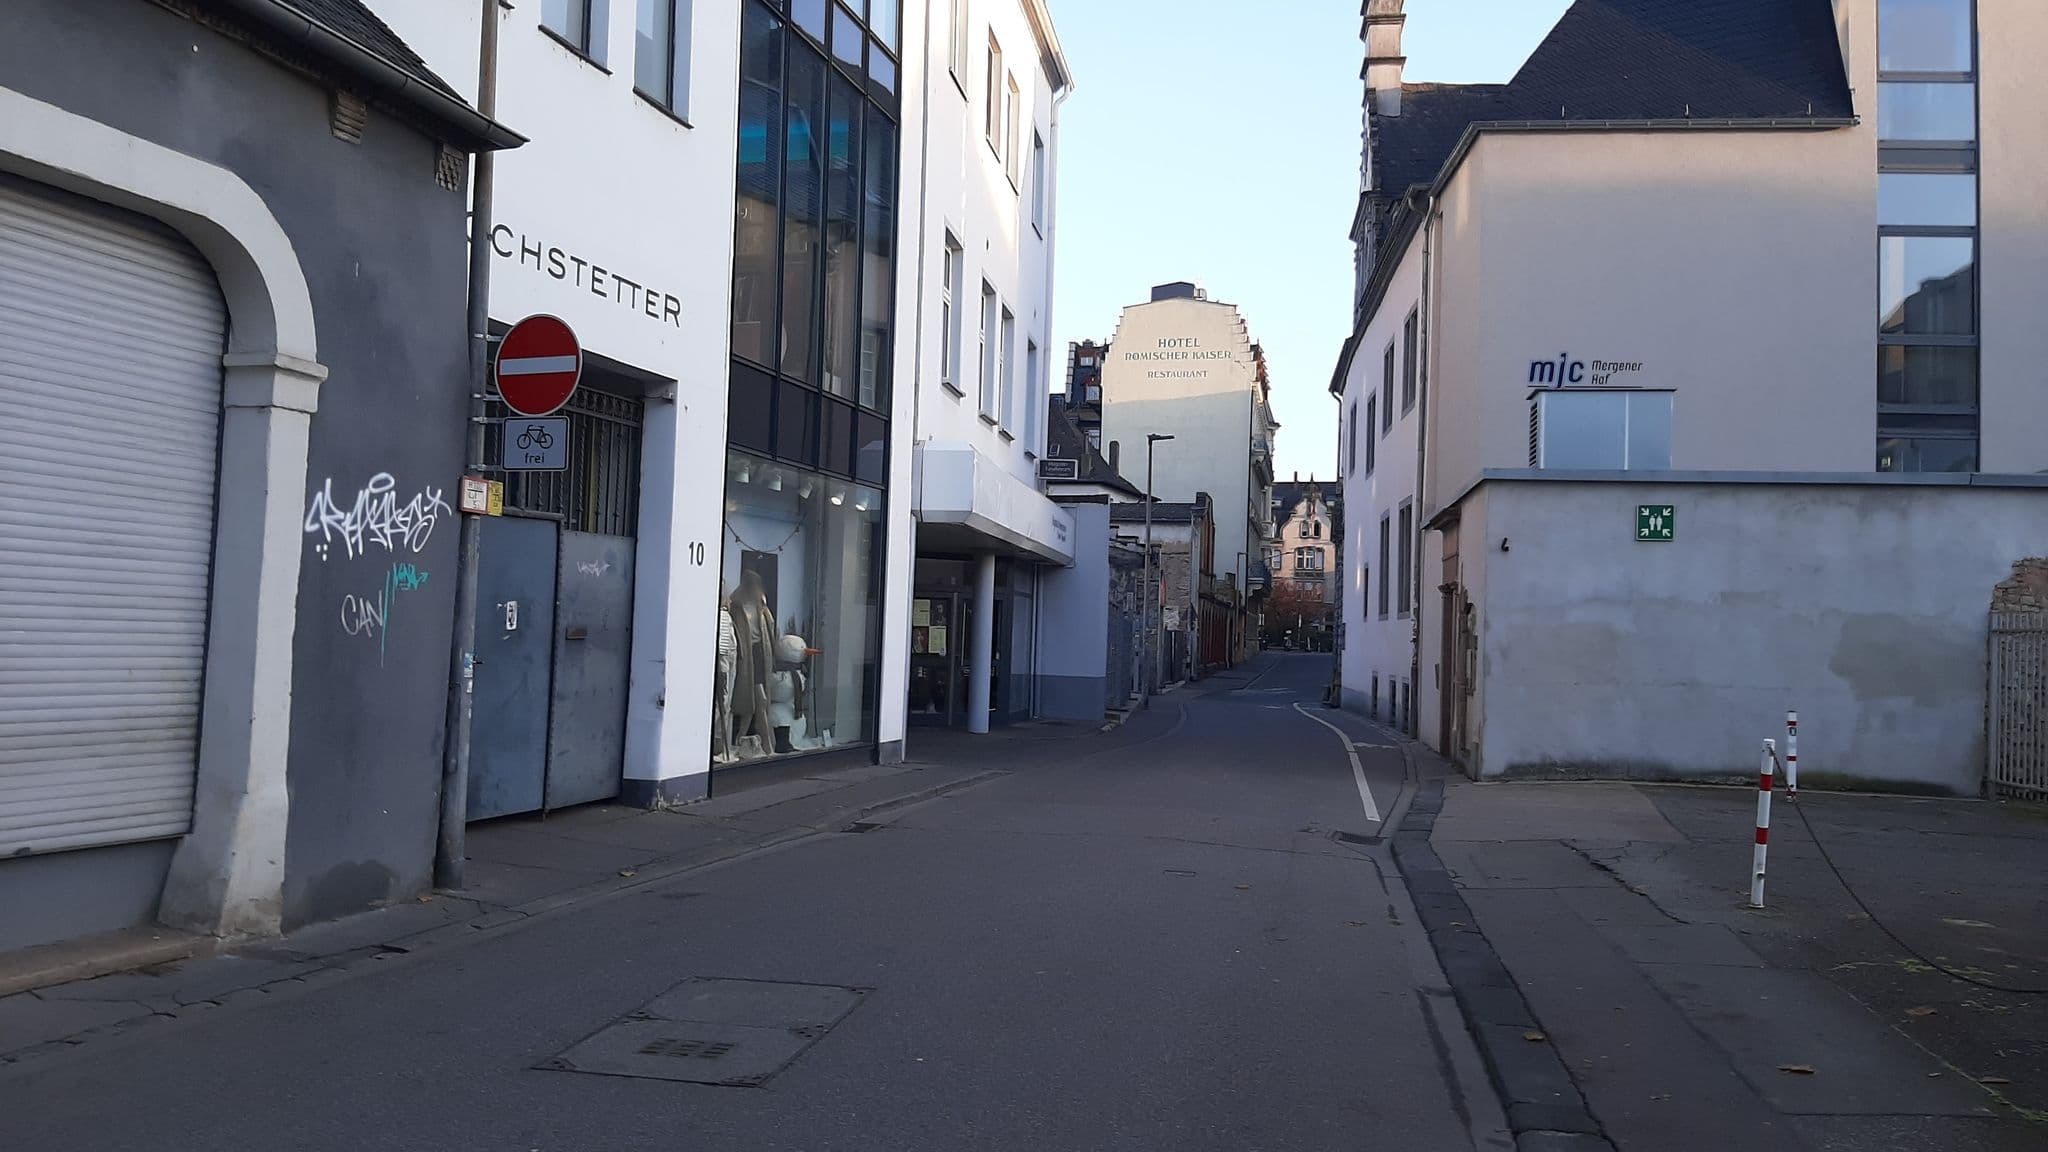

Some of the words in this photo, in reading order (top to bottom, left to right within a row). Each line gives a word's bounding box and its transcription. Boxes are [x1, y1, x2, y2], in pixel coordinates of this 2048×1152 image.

[490, 223, 681, 328] CHSTETTER
[1158, 338, 1201, 348] HOTEL
[1192, 350, 1232, 360] KAISER
[1591, 360, 1643, 373] Mergener
[1147, 370, 1208, 379] RESTAURANT
[524, 452, 545, 464] frei
[689, 541, 704, 566] 10
